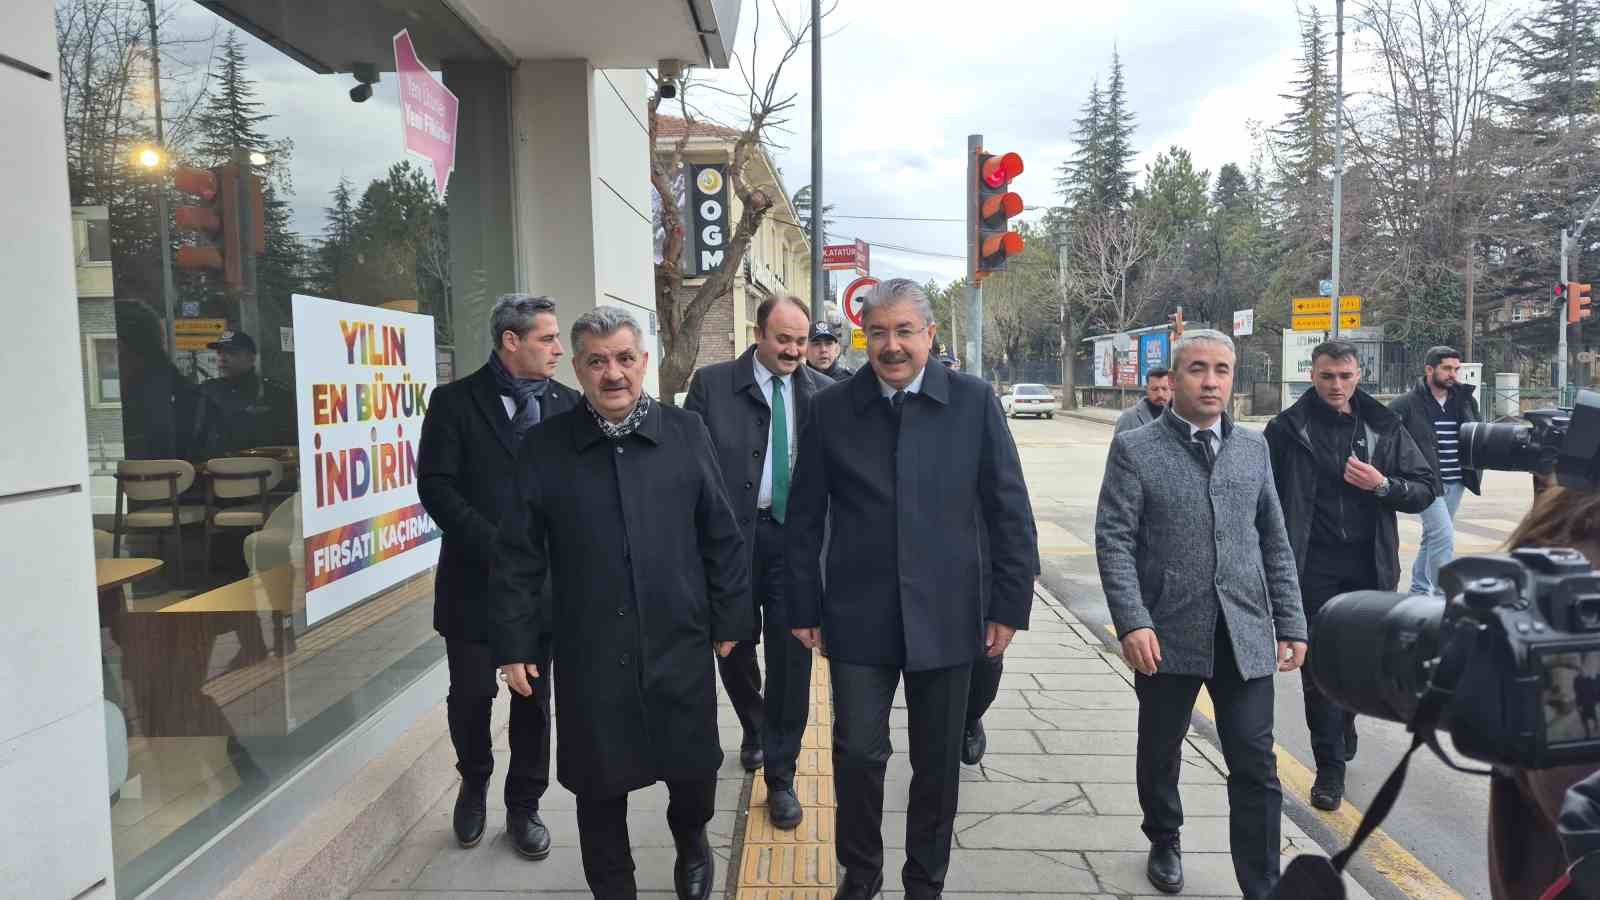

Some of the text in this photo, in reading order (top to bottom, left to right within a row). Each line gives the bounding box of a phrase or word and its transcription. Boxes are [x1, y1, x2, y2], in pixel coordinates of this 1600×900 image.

[700, 200, 724, 271] OGM
[339, 320, 406, 366] YILIN
[312, 372, 427, 425] EN BÜYÜK
[314, 531, 375, 576] FIRSATI
